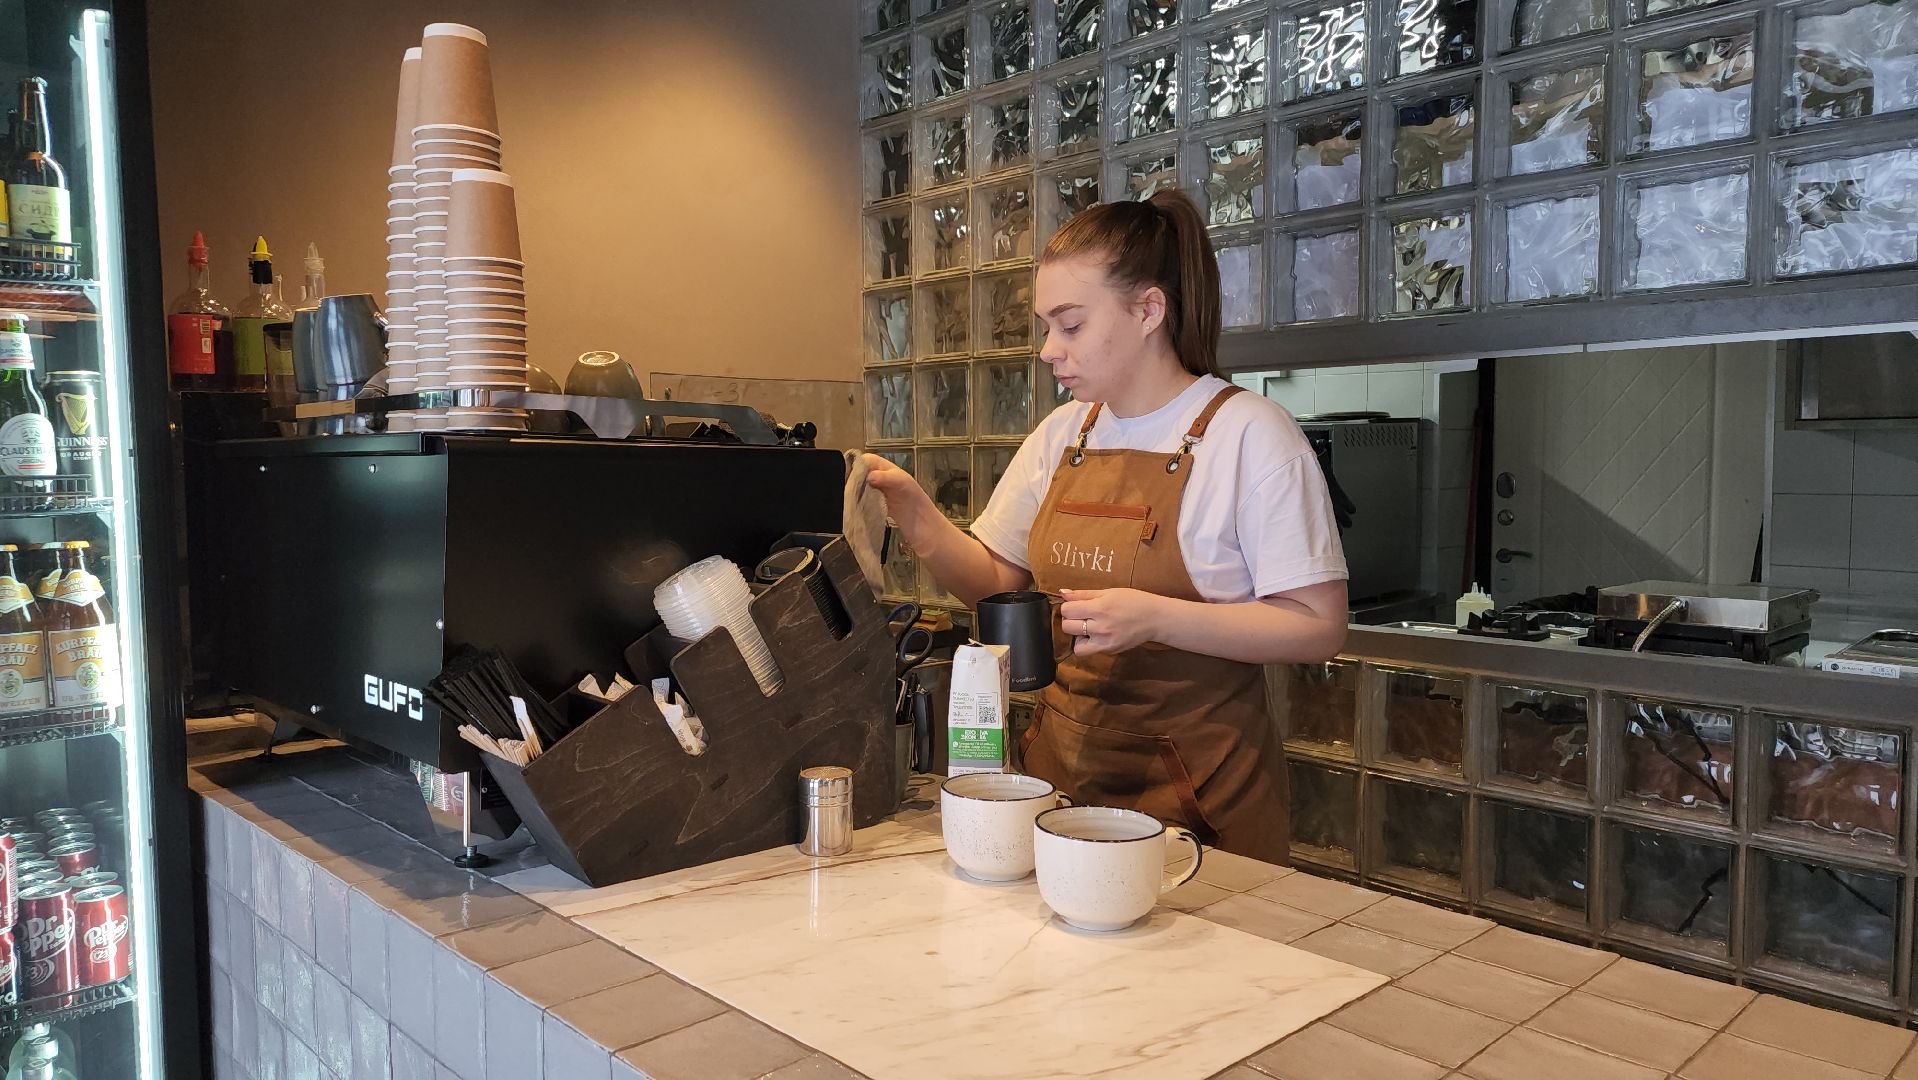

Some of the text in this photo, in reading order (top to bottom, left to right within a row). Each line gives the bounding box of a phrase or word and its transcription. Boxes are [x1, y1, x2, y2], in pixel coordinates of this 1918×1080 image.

[0, 446, 52, 456] CLAUSTH
[1050, 541, 1114, 572] Slivki
[56, 636, 100, 653] KURPF
[364, 674, 423, 721] GUFO
[26, 916, 58, 938] Dr
